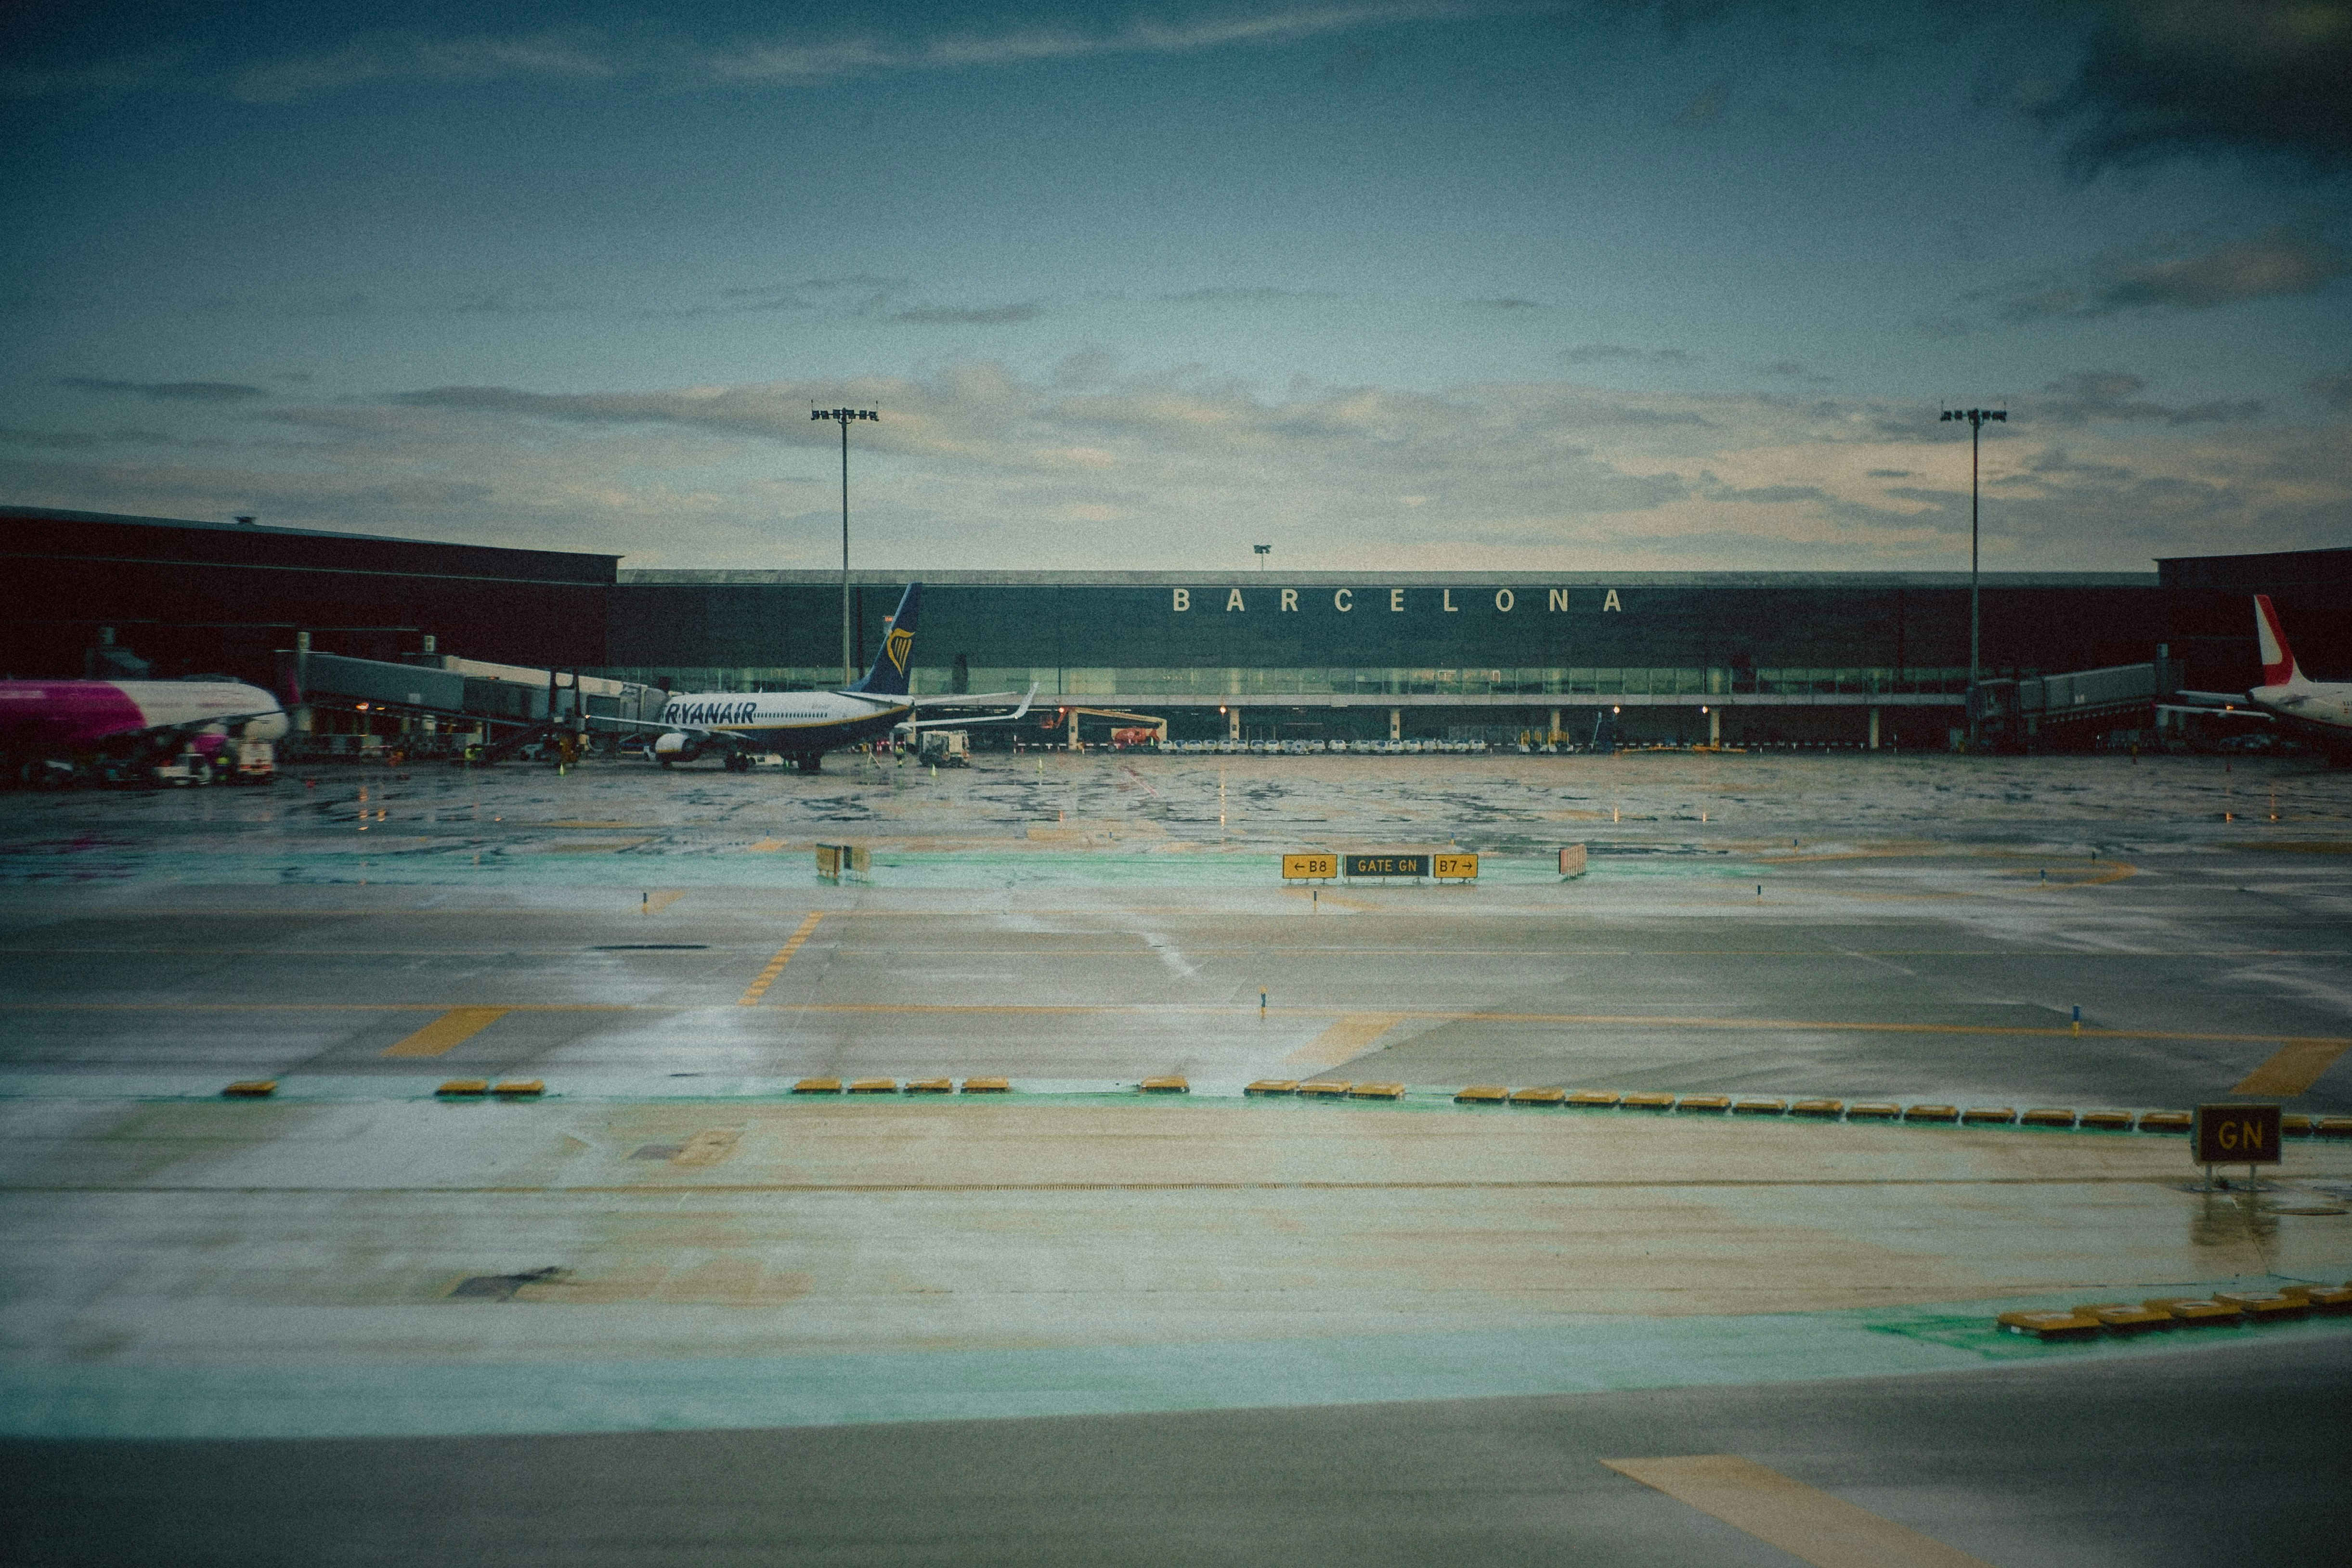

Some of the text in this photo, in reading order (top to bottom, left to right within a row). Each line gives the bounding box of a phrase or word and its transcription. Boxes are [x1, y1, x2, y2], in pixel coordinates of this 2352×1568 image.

[1173, 588, 1621, 611] BARCELONA
[665, 702, 757, 724] RYANAIR
[1310, 861, 1326, 872] B8
[1358, 859, 1416, 872] GATE GN
[1440, 860, 1457, 872] B7
[2218, 1121, 2262, 1150] GN
